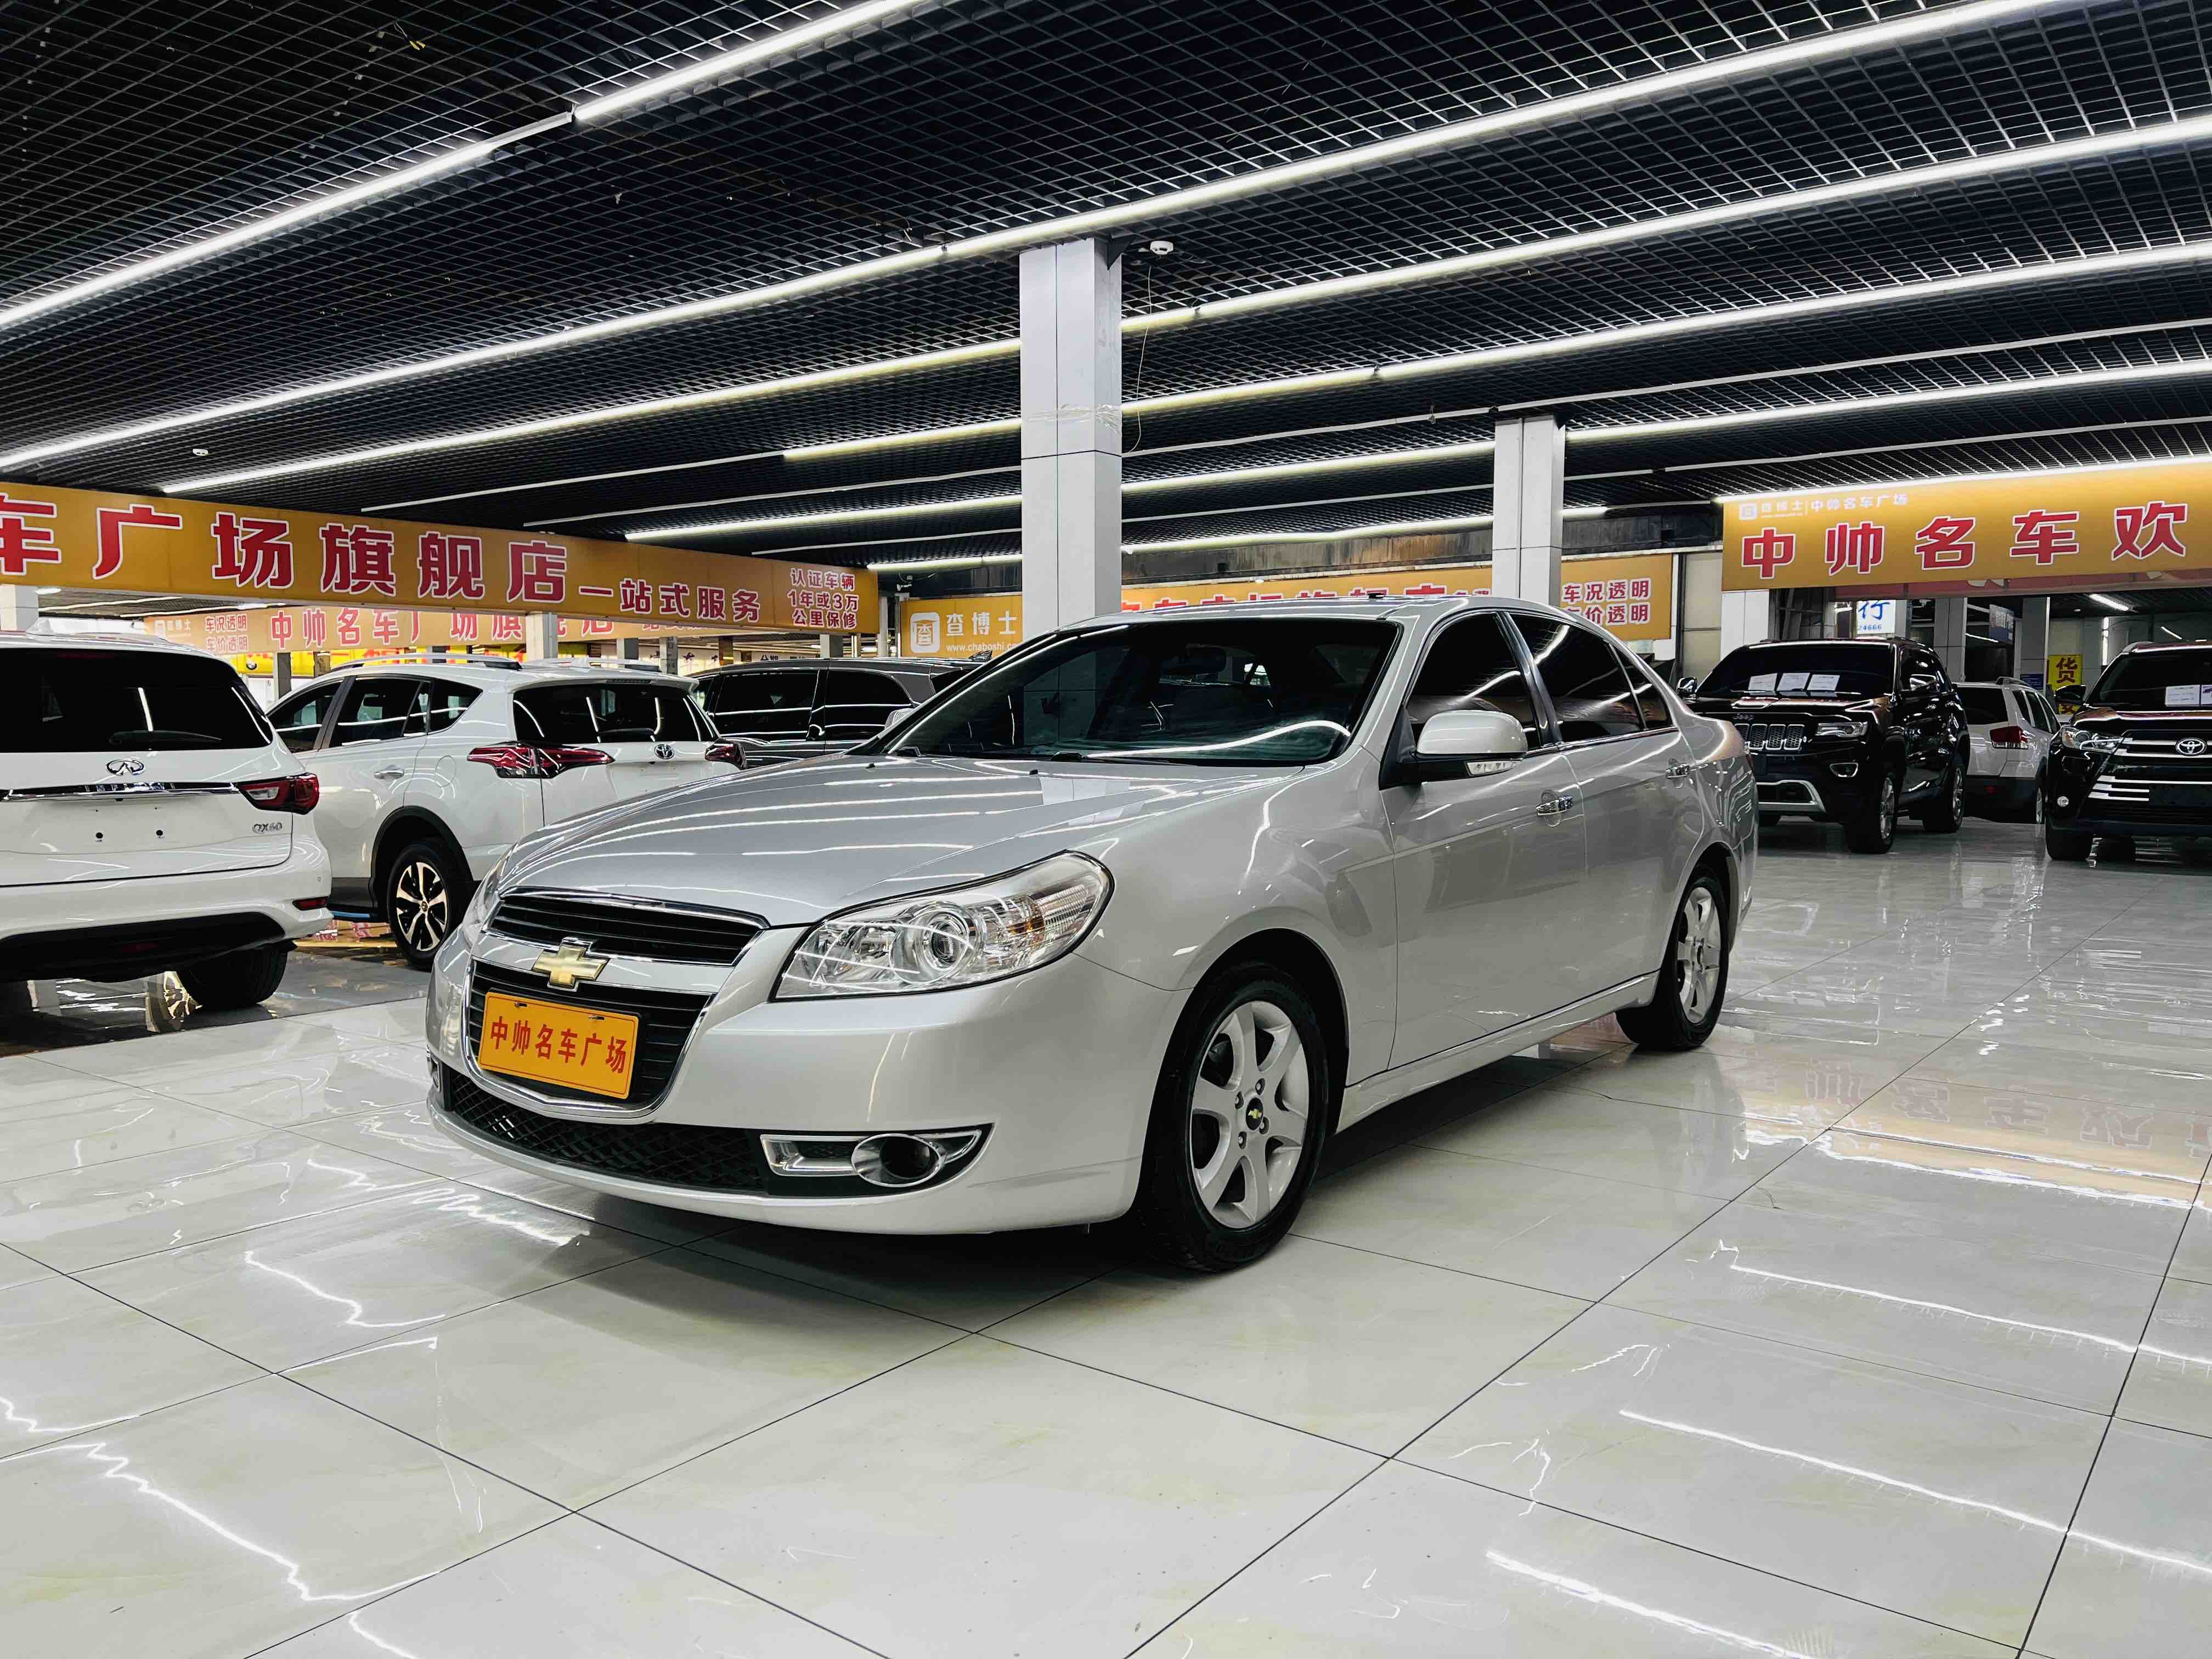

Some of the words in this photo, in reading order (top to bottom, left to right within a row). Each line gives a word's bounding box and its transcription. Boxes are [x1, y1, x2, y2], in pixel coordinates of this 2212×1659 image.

[1741, 500, 2189, 579] 中帅名车欢
[0, 492, 567, 603] 车广场旗舰店
[579, 578, 761, 623] 一站式服务
[790, 568, 855, 591] 认证车辆
[1563, 578, 1650, 602] 车况透明
[787, 589, 859, 611] 1年或3万
[204, 614, 247, 633] 车况透明
[793, 610, 857, 629] 公里保修
[946, 610, 1017, 636] 查博士
[1567, 602, 1650, 625] 价透明
[206, 635, 247, 653] 车价透明
[946, 641, 1020, 652] www.chaboshi.co
[2056, 657, 2078, 684] 货
[490, 1015, 628, 1074] 中帅名车广场
